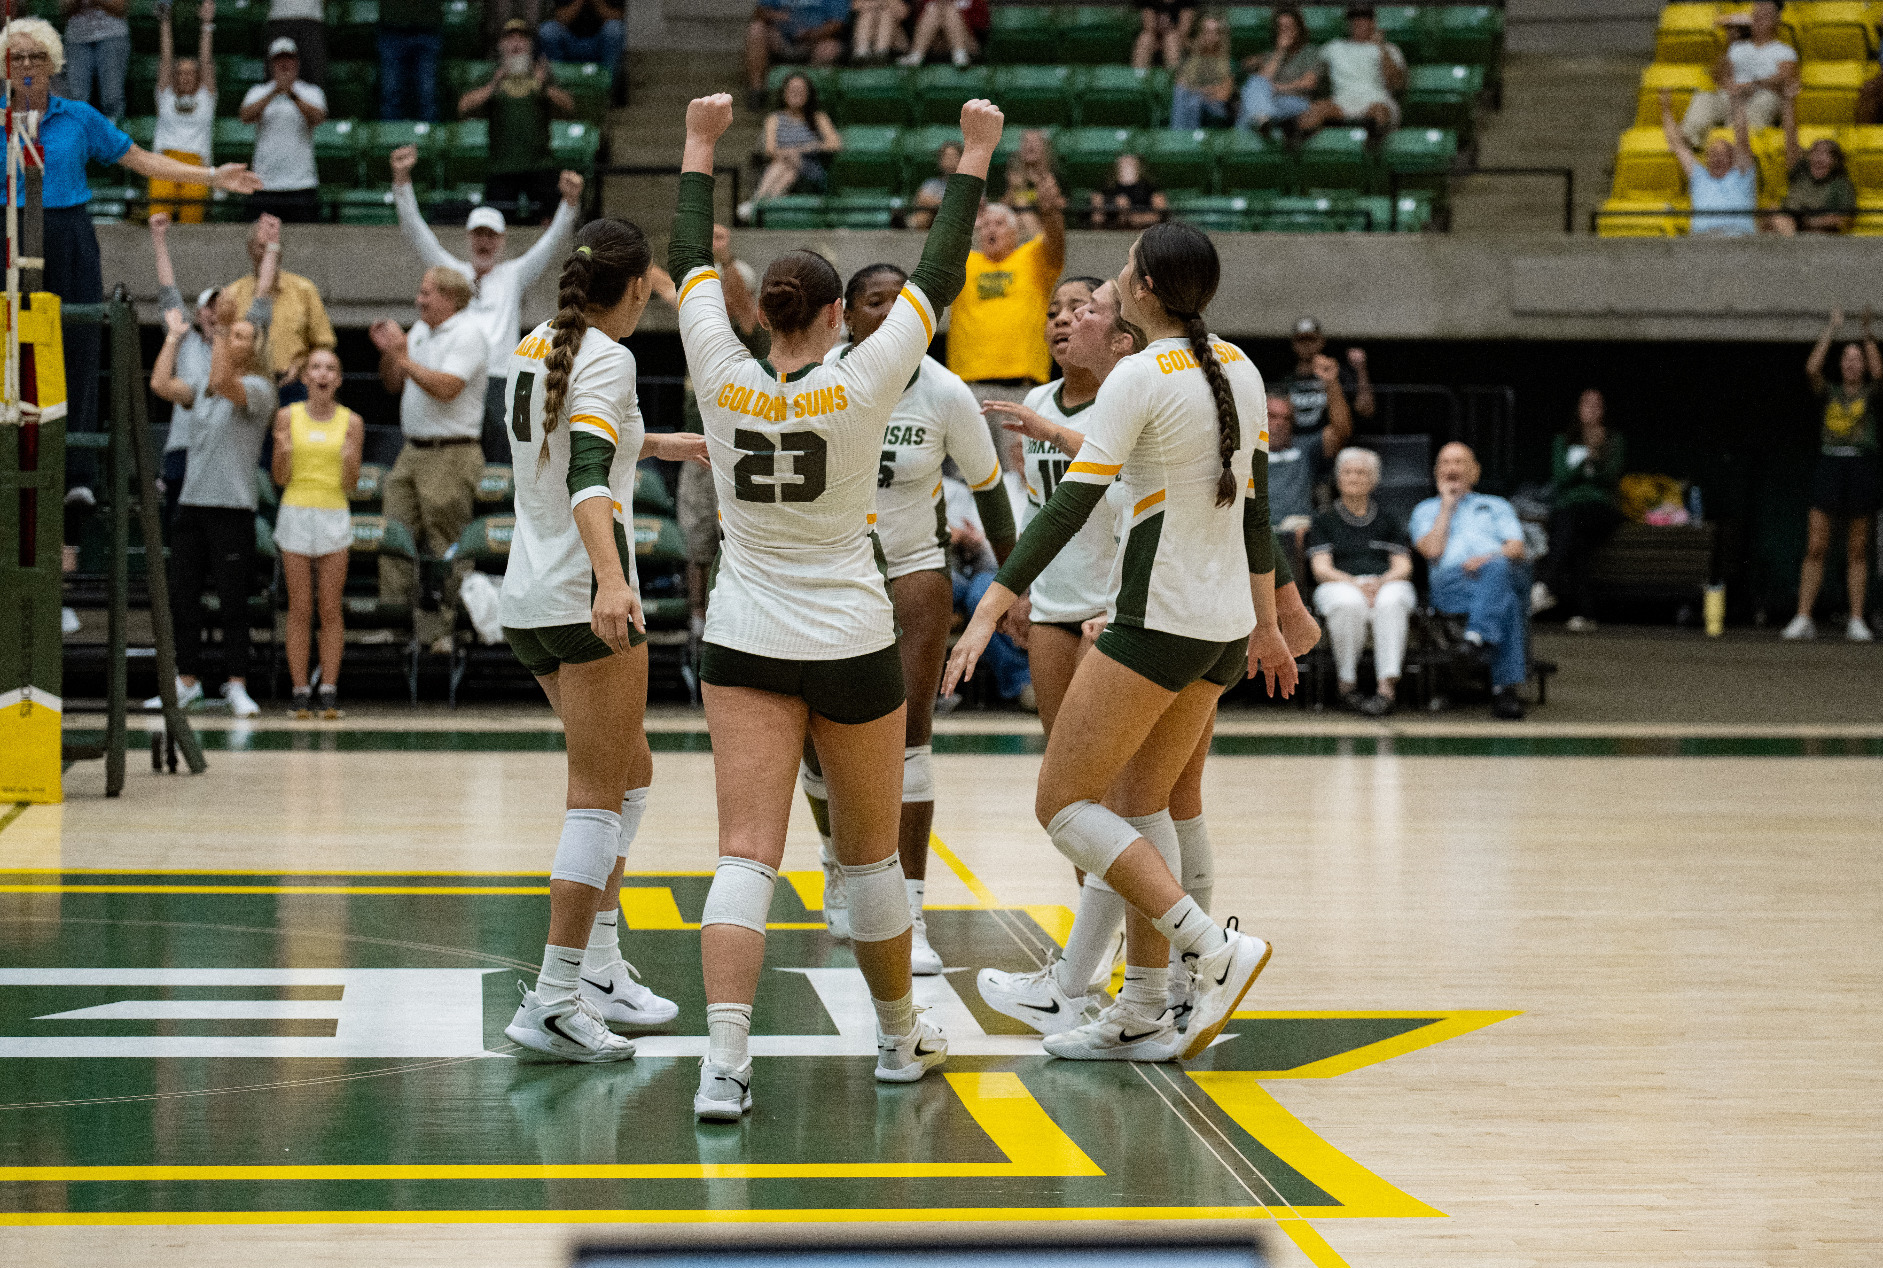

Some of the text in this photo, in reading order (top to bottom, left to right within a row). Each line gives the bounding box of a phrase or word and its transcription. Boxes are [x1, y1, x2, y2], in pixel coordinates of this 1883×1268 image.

[717, 383, 848, 422] GOLDEN SUNS
[733, 428, 827, 503] 23
